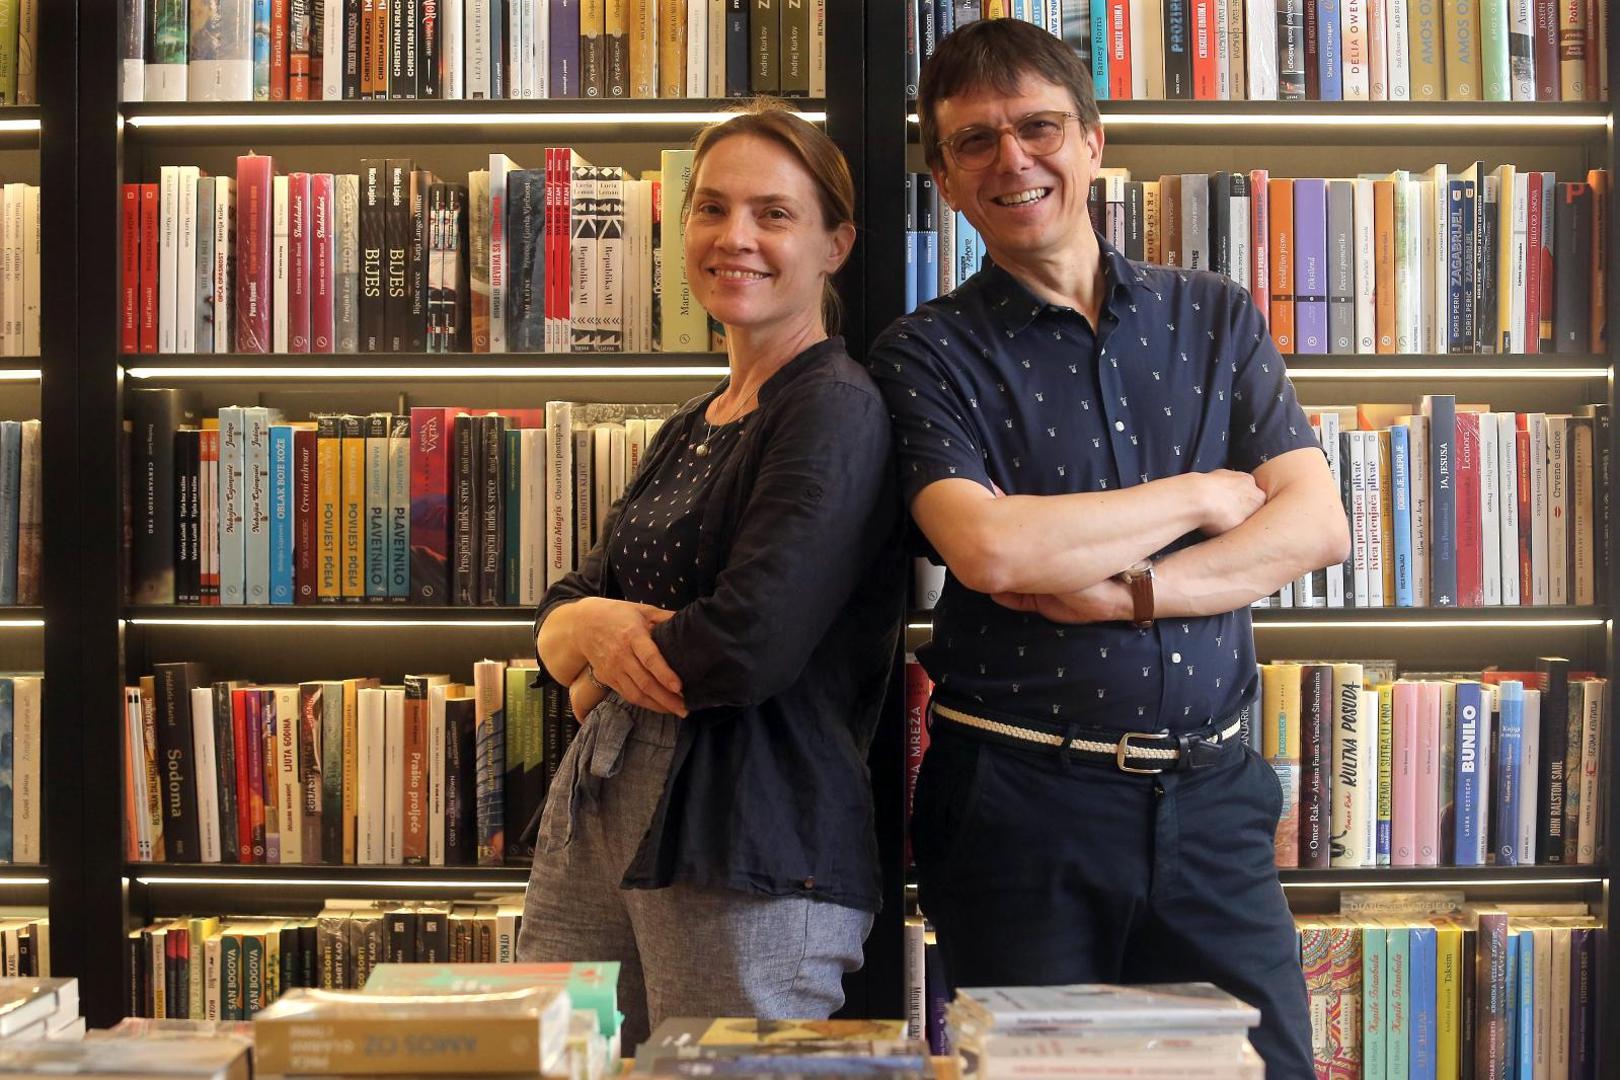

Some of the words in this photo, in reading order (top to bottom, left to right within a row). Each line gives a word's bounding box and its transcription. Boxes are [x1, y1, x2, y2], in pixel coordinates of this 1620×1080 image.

[393, 0, 401, 27] KRACH
[406, 0, 414, 27] KRACH
[1114, 4, 1123, 30] OBIOMA
[1198, 2, 1207, 27] OBIOMA
[1349, 0, 1358, 34] OWEN
[1538, 2, 1547, 29] JOSEPH
[761, 25, 769, 52] Kurkov
[791, 25, 800, 52] Kurkov
[925, 13, 934, 56] Nooteboom
[1095, 17, 1103, 43] Norris
[1421, 19, 1433, 65] AMOS
[1458, 19, 1470, 65] AMOS
[393, 29, 401, 77] CHRISTIAN
[761, 53, 770, 77] Andrej
[791, 53, 800, 77] Andrej
[1097, 47, 1105, 76] Barney
[1326, 58, 1334, 78] Sheila
[1350, 38, 1360, 74] DELIA
[293, 196, 303, 239] Sladoledari
[316, 196, 326, 239] Sladoledari
[413, 243, 421, 262] Katja
[1450, 208, 1462, 287] ZAGABRIJEL
[365, 249, 380, 297] BIJES
[389, 249, 404, 297] BIJES
[492, 254, 501, 287] DJEVOJKA
[579, 246, 589, 290] Republika
[604, 246, 614, 291] Republika
[1339, 271, 1347, 291] Devet
[216, 286, 224, 303] OPĆA
[413, 289, 421, 315] Bijesne
[680, 287, 689, 316] Mario
[1451, 292, 1459, 314] PERIĆ
[1464, 291, 1472, 312] PERIĆ
[275, 438, 284, 462] KOŽE
[1439, 442, 1449, 475] JESUSA
[1461, 431, 1471, 470] Leonora
[1553, 430, 1562, 459] usnice
[276, 462, 284, 485] BOJE
[301, 447, 310, 481] adresar
[1552, 460, 1562, 498] Crvene
[457, 480, 470, 504] sreće
[484, 480, 496, 504] sreće
[554, 460, 563, 500] Obustaviti
[1440, 475, 1450, 489] JA,
[276, 486, 284, 519] OBLAK
[301, 481, 310, 513] Crveni
[226, 502, 235, 534] Nebojša
[252, 502, 261, 534] Nebojša
[324, 503, 334, 551] POVIJEST
[348, 503, 358, 551] POVIJEST
[457, 505, 469, 532] indeks
[484, 505, 496, 532] indeks
[554, 505, 565, 535] Magris
[1354, 494, 1366, 544] prtenjača
[1369, 494, 1380, 544] prtenjača
[371, 507, 382, 585] PLAVETNILO
[394, 507, 406, 585] PLAVETNILO
[457, 534, 470, 573] Prosječni
[484, 534, 496, 573] Prosječni
[554, 536, 563, 569] Claudio
[1355, 546, 1365, 571] ivica
[1369, 546, 1379, 571] ivica
[324, 556, 335, 587] PČELA
[348, 556, 359, 587] PČELA
[1341, 680, 1361, 733] POSUDA
[1379, 703, 1390, 725] KINO
[282, 718, 291, 747] GODINA
[909, 705, 921, 757] MREŽA
[1461, 704, 1476, 773] BUNILO
[283, 749, 292, 773] LJUTA
[1312, 744, 1320, 767] Fausta
[1338, 738, 1358, 788] KULTNA
[1379, 737, 1390, 767] SUTRA
[167, 748, 184, 818] Sodoma
[410, 751, 421, 789] Praško
[1311, 767, 1320, 793] Arkana
[1380, 769, 1390, 779] LI
[1551, 760, 1563, 780] SAUL
[409, 790, 422, 834] proljeće
[1310, 803, 1320, 823] Rak
[1379, 782, 1391, 817] HOĆEMO
[1551, 781, 1563, 817] RALSTON
[1309, 823, 1320, 850] Omer
[1550, 817, 1562, 837] JOHN
[368, 931, 376, 941] JA
[227, 949, 237, 989] BOGOVA
[250, 949, 259, 989] BOGOVA
[324, 946, 332, 972] SORTI
[357, 946, 365, 972] SORTI
[1445, 953, 1453, 984] Taksim
[228, 989, 237, 1010] SAN
[250, 989, 259, 1010] SAN
[1489, 1020, 1497, 1059] SCHUBERTH
